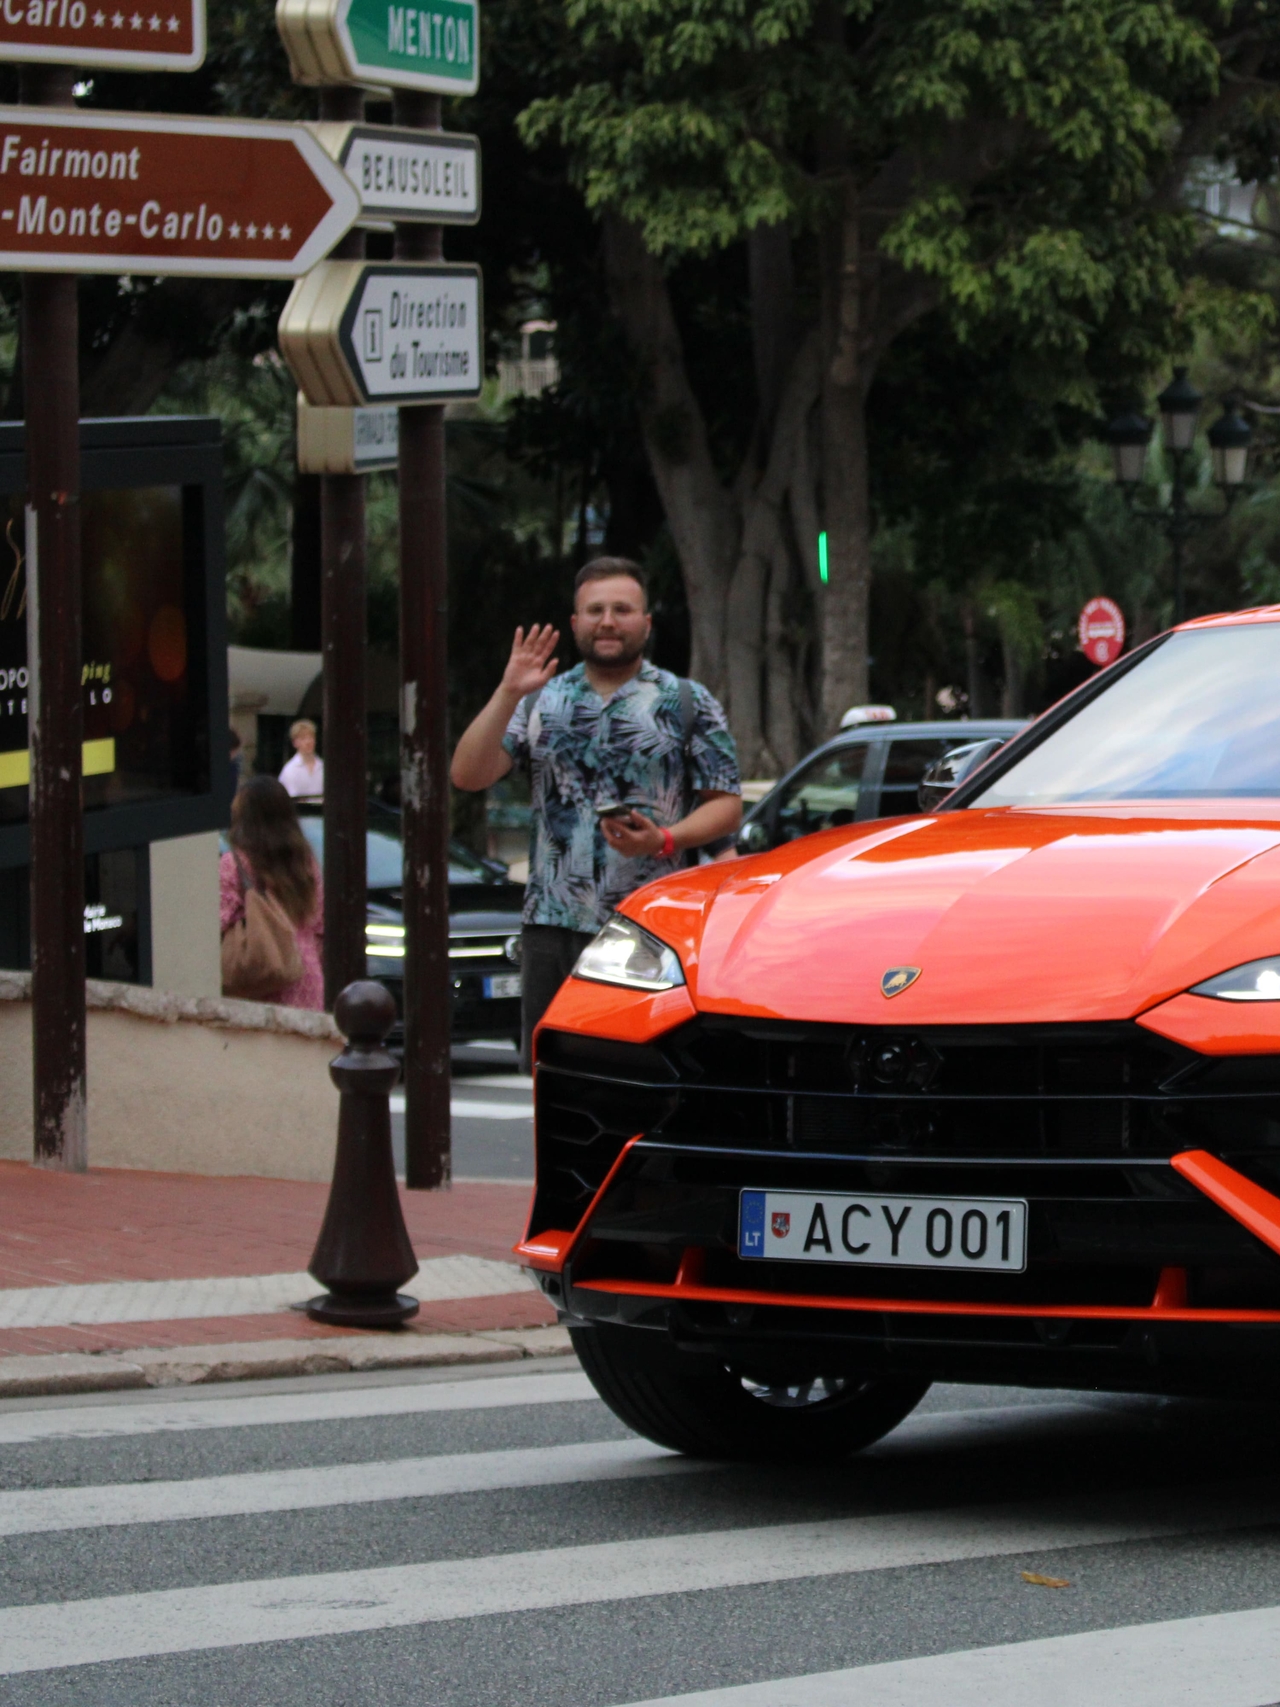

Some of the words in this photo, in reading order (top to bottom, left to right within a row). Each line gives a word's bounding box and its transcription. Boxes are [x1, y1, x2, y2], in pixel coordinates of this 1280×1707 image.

[387, 4, 470, 64] MENTON
[0, 134, 141, 180] Fairmont
[362, 153, 468, 198] BEAUSOLEIL
[389, 290, 467, 329] Direction
[390, 342, 407, 379] du
[411, 340, 469, 378] Tourisme
[744, 1231, 761, 1247] LT
